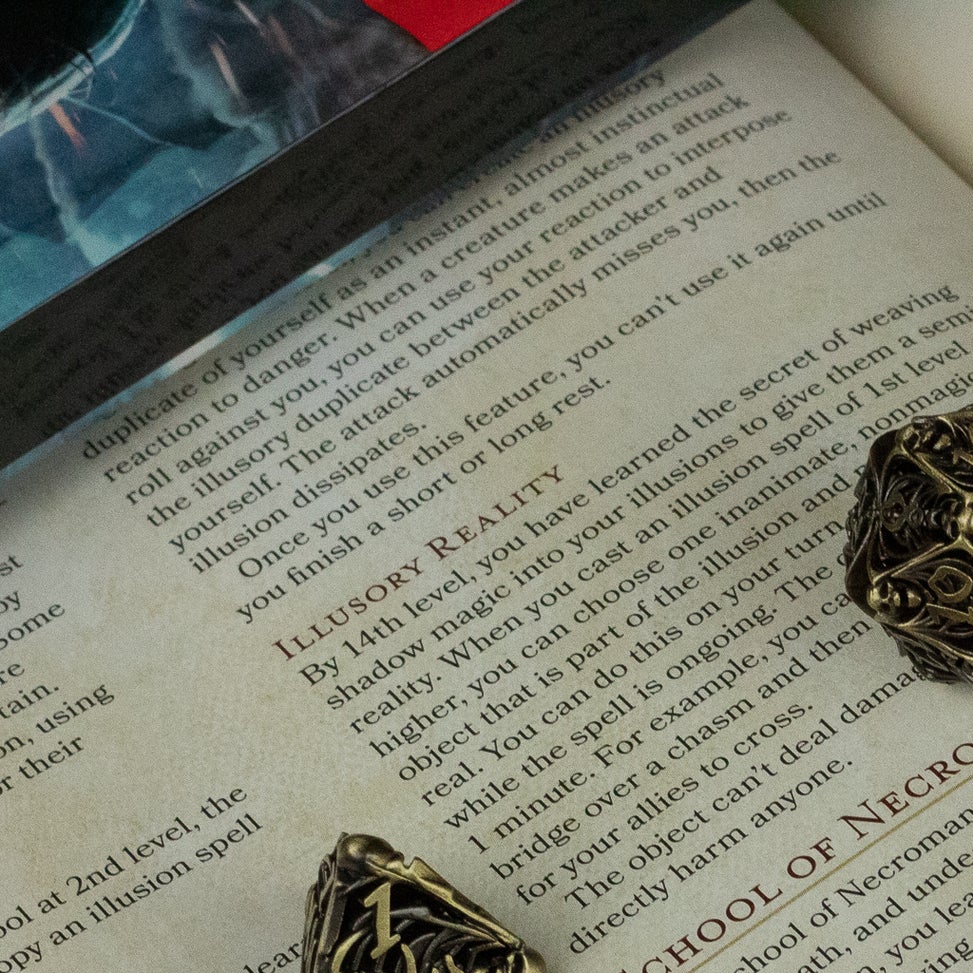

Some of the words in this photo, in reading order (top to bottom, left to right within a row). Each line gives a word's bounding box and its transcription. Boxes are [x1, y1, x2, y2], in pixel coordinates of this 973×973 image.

[103, 413, 209, 483] reaction
[211, 394, 239, 413] to
[243, 333, 337, 393] danger.
[335, 282, 416, 330] When
[420, 269, 437, 283] a
[441, 202, 541, 269] creature
[549, 155, 632, 203] makes
[639, 133, 668, 154] an
[676, 96, 748, 135] attack
[238, 532, 305, 578] Once
[312, 498, 361, 538] you
[363, 466, 406, 499] use
[412, 434, 464, 467] this
[464, 371, 566, 433] feature,
[566, 335, 614, 372] you
[682, 267, 723, 296] use
[731, 253, 750, 269] it
[755, 219, 824, 257] again
[827, 192, 886, 221] until
[236, 584, 287, 624] you
[286, 535, 363, 586] finish
[367, 521, 385, 536] a
[387, 473, 456, 518] short
[459, 451, 486, 474] or
[487, 411, 553, 454] long
[552, 377, 611, 415] rest.
[273, 557, 423, 661] ILLUSORY
[425, 465, 563, 561] REALITY
[299, 656, 339, 686] By
[342, 617, 405, 658] 14th
[402, 569, 477, 619] level,
[476, 535, 527, 577] you
[523, 493, 590, 538] have
[587, 423, 692, 495] learned
[692, 399, 732, 429] the
[739, 349, 819, 401] secret
[821, 328, 848, 352] of
[849, 285, 960, 336] weaving
[489, 817, 581, 880] bridge
[584, 773, 639, 818] over
[645, 760, 666, 777] a
[667, 698, 755, 760] chasm
[757, 656, 809, 700] and
[809, 620, 872, 663] then
[516, 872, 556, 906] for
[560, 827, 621, 881] your
[627, 777, 700, 831] allies
[700, 756, 730, 778] to
[733, 704, 813, 756] cross.
[37, 891, 66, 914] at
[65, 855, 125, 896] 2nd
[122, 816, 201, 864] level,
[200, 788, 247, 820] the
[363, 881, 401, 960] 1
[569, 879, 669, 955] directly
[667, 827, 748, 882] harm
[750, 760, 853, 829] anyone.
[786, 836, 839, 879] OF
[809, 897, 838, 928] of
[853, 896, 906, 942] and
